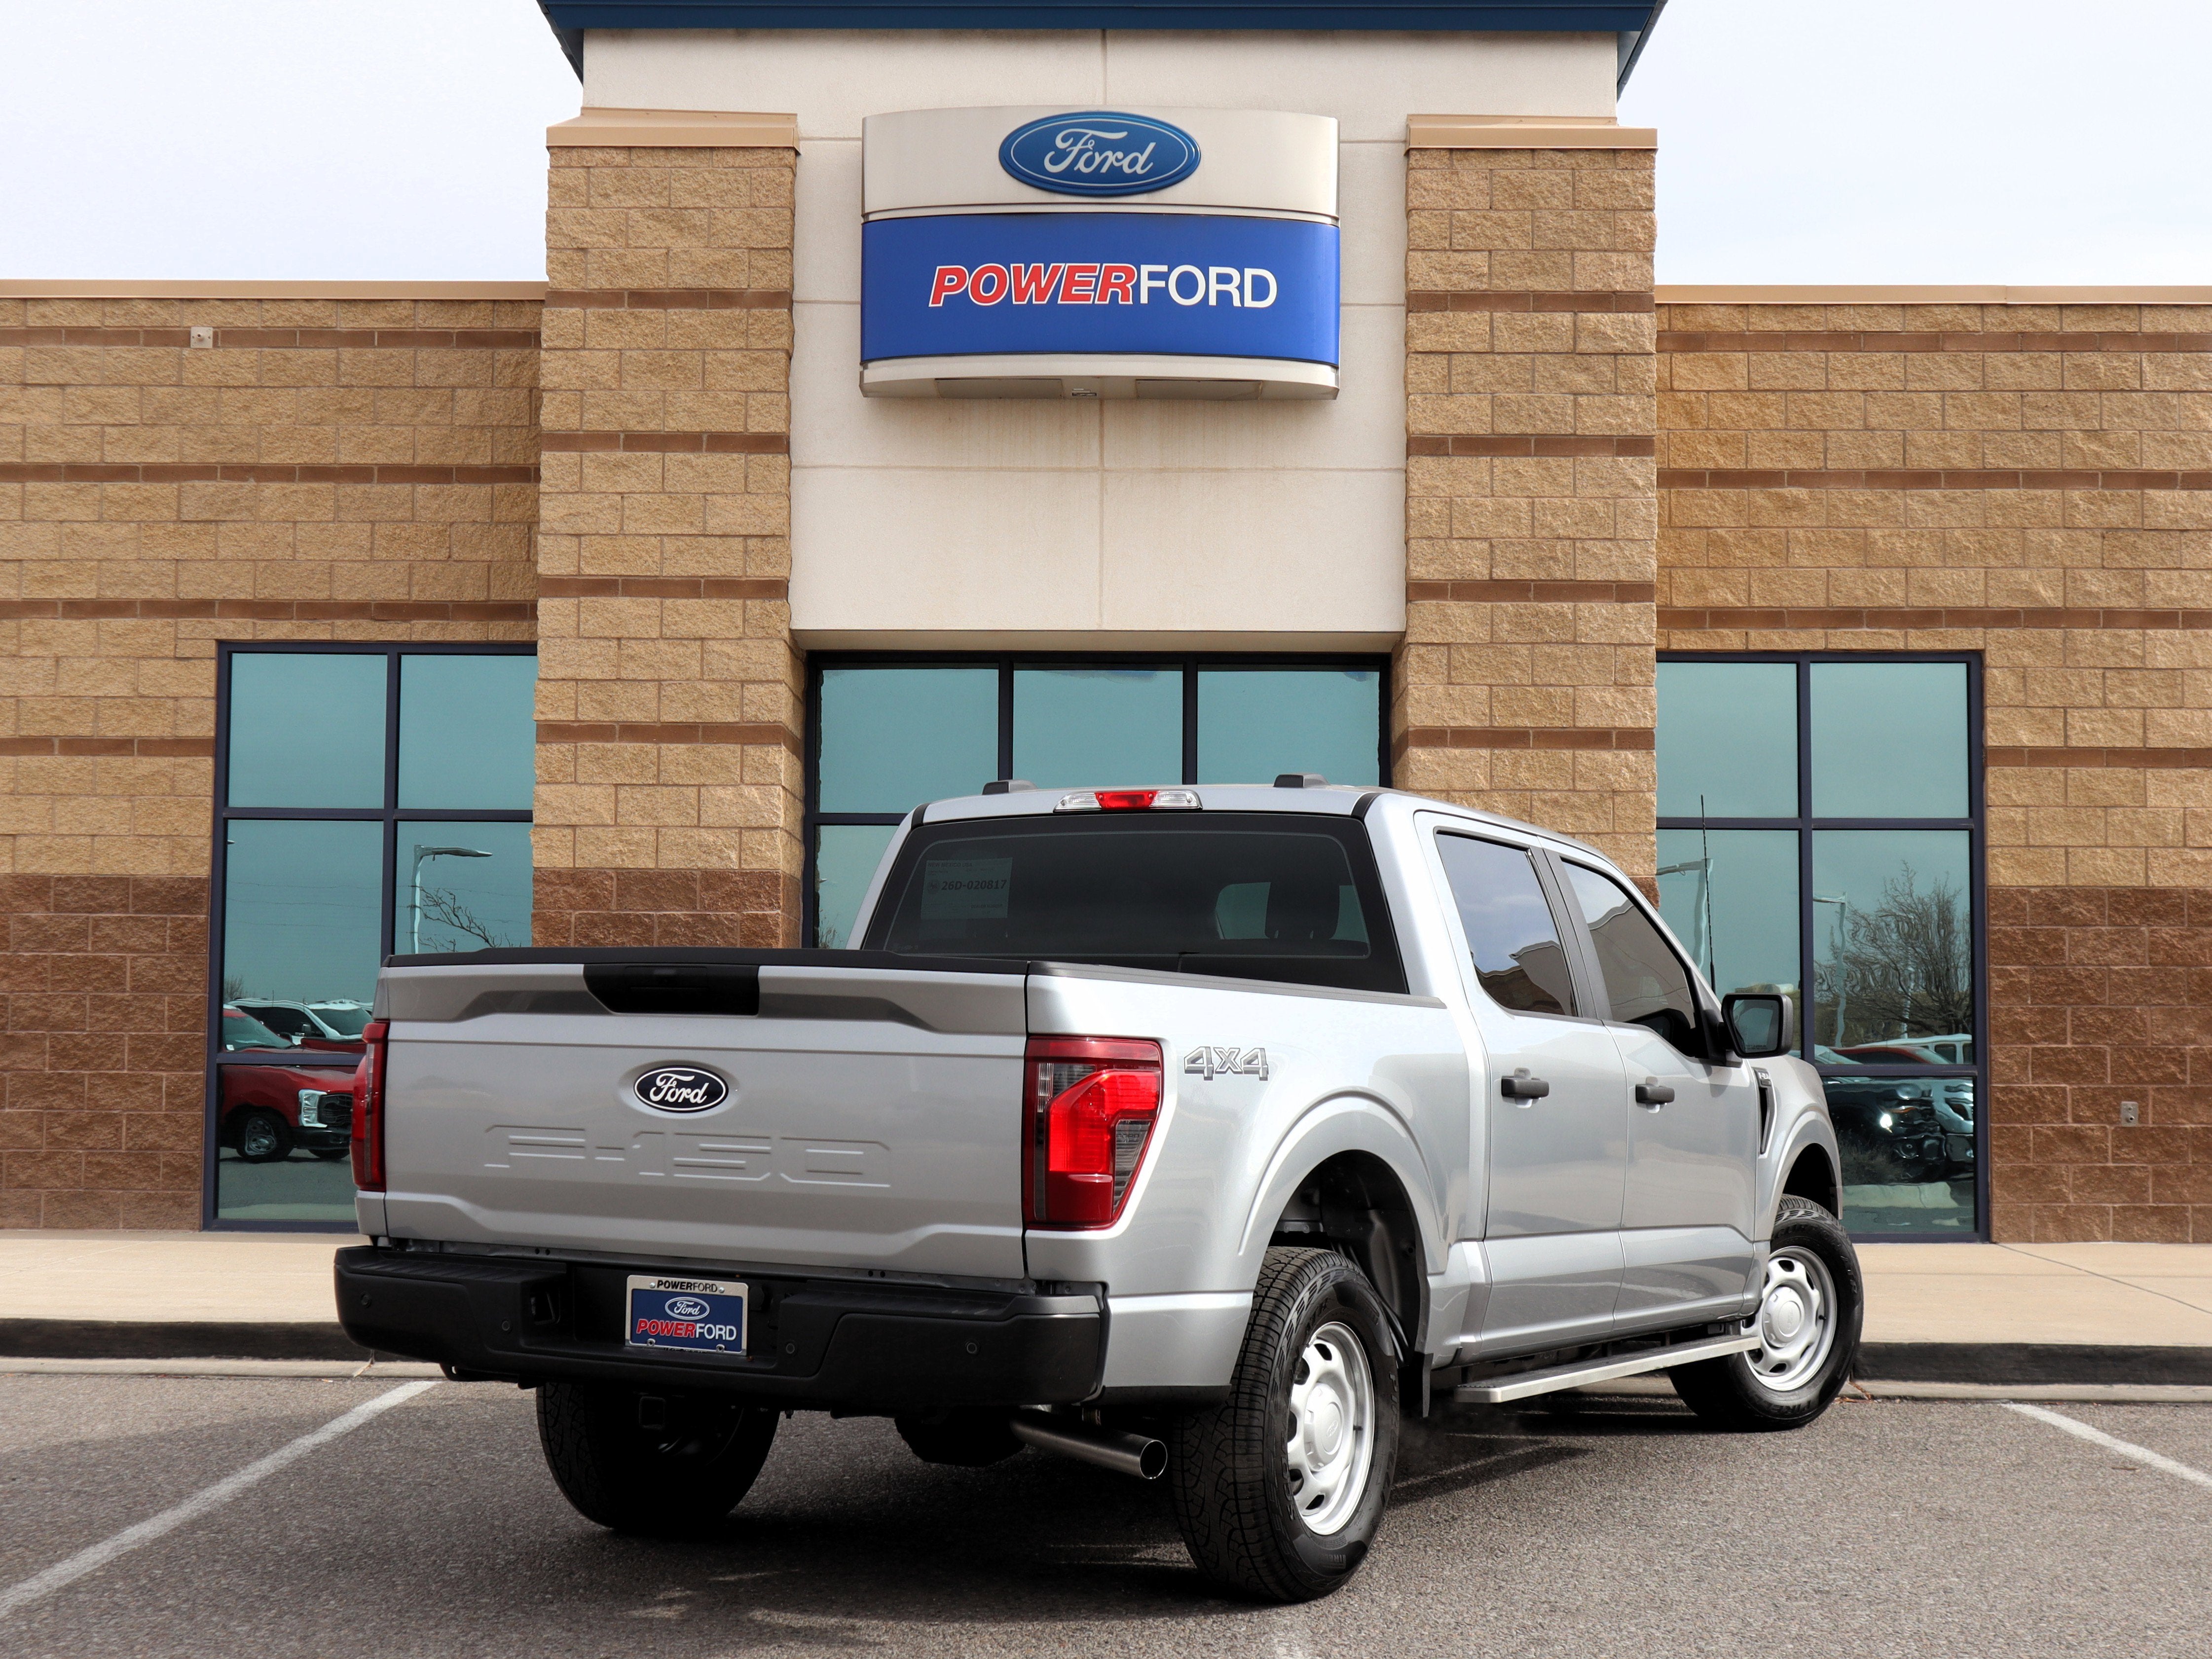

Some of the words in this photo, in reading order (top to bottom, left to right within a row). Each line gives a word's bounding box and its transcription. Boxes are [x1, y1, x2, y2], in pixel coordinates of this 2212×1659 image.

[1044, 128, 1156, 175] Ford
[928, 262, 1278, 308] POWERFORD
[941, 879, 1007, 890] 26D-020817
[649, 1072, 709, 1104] Ford
[656, 1280, 718, 1292] POWERFORD
[673, 1300, 701, 1316] Ford
[636, 1318, 737, 1341] POWERFORD
